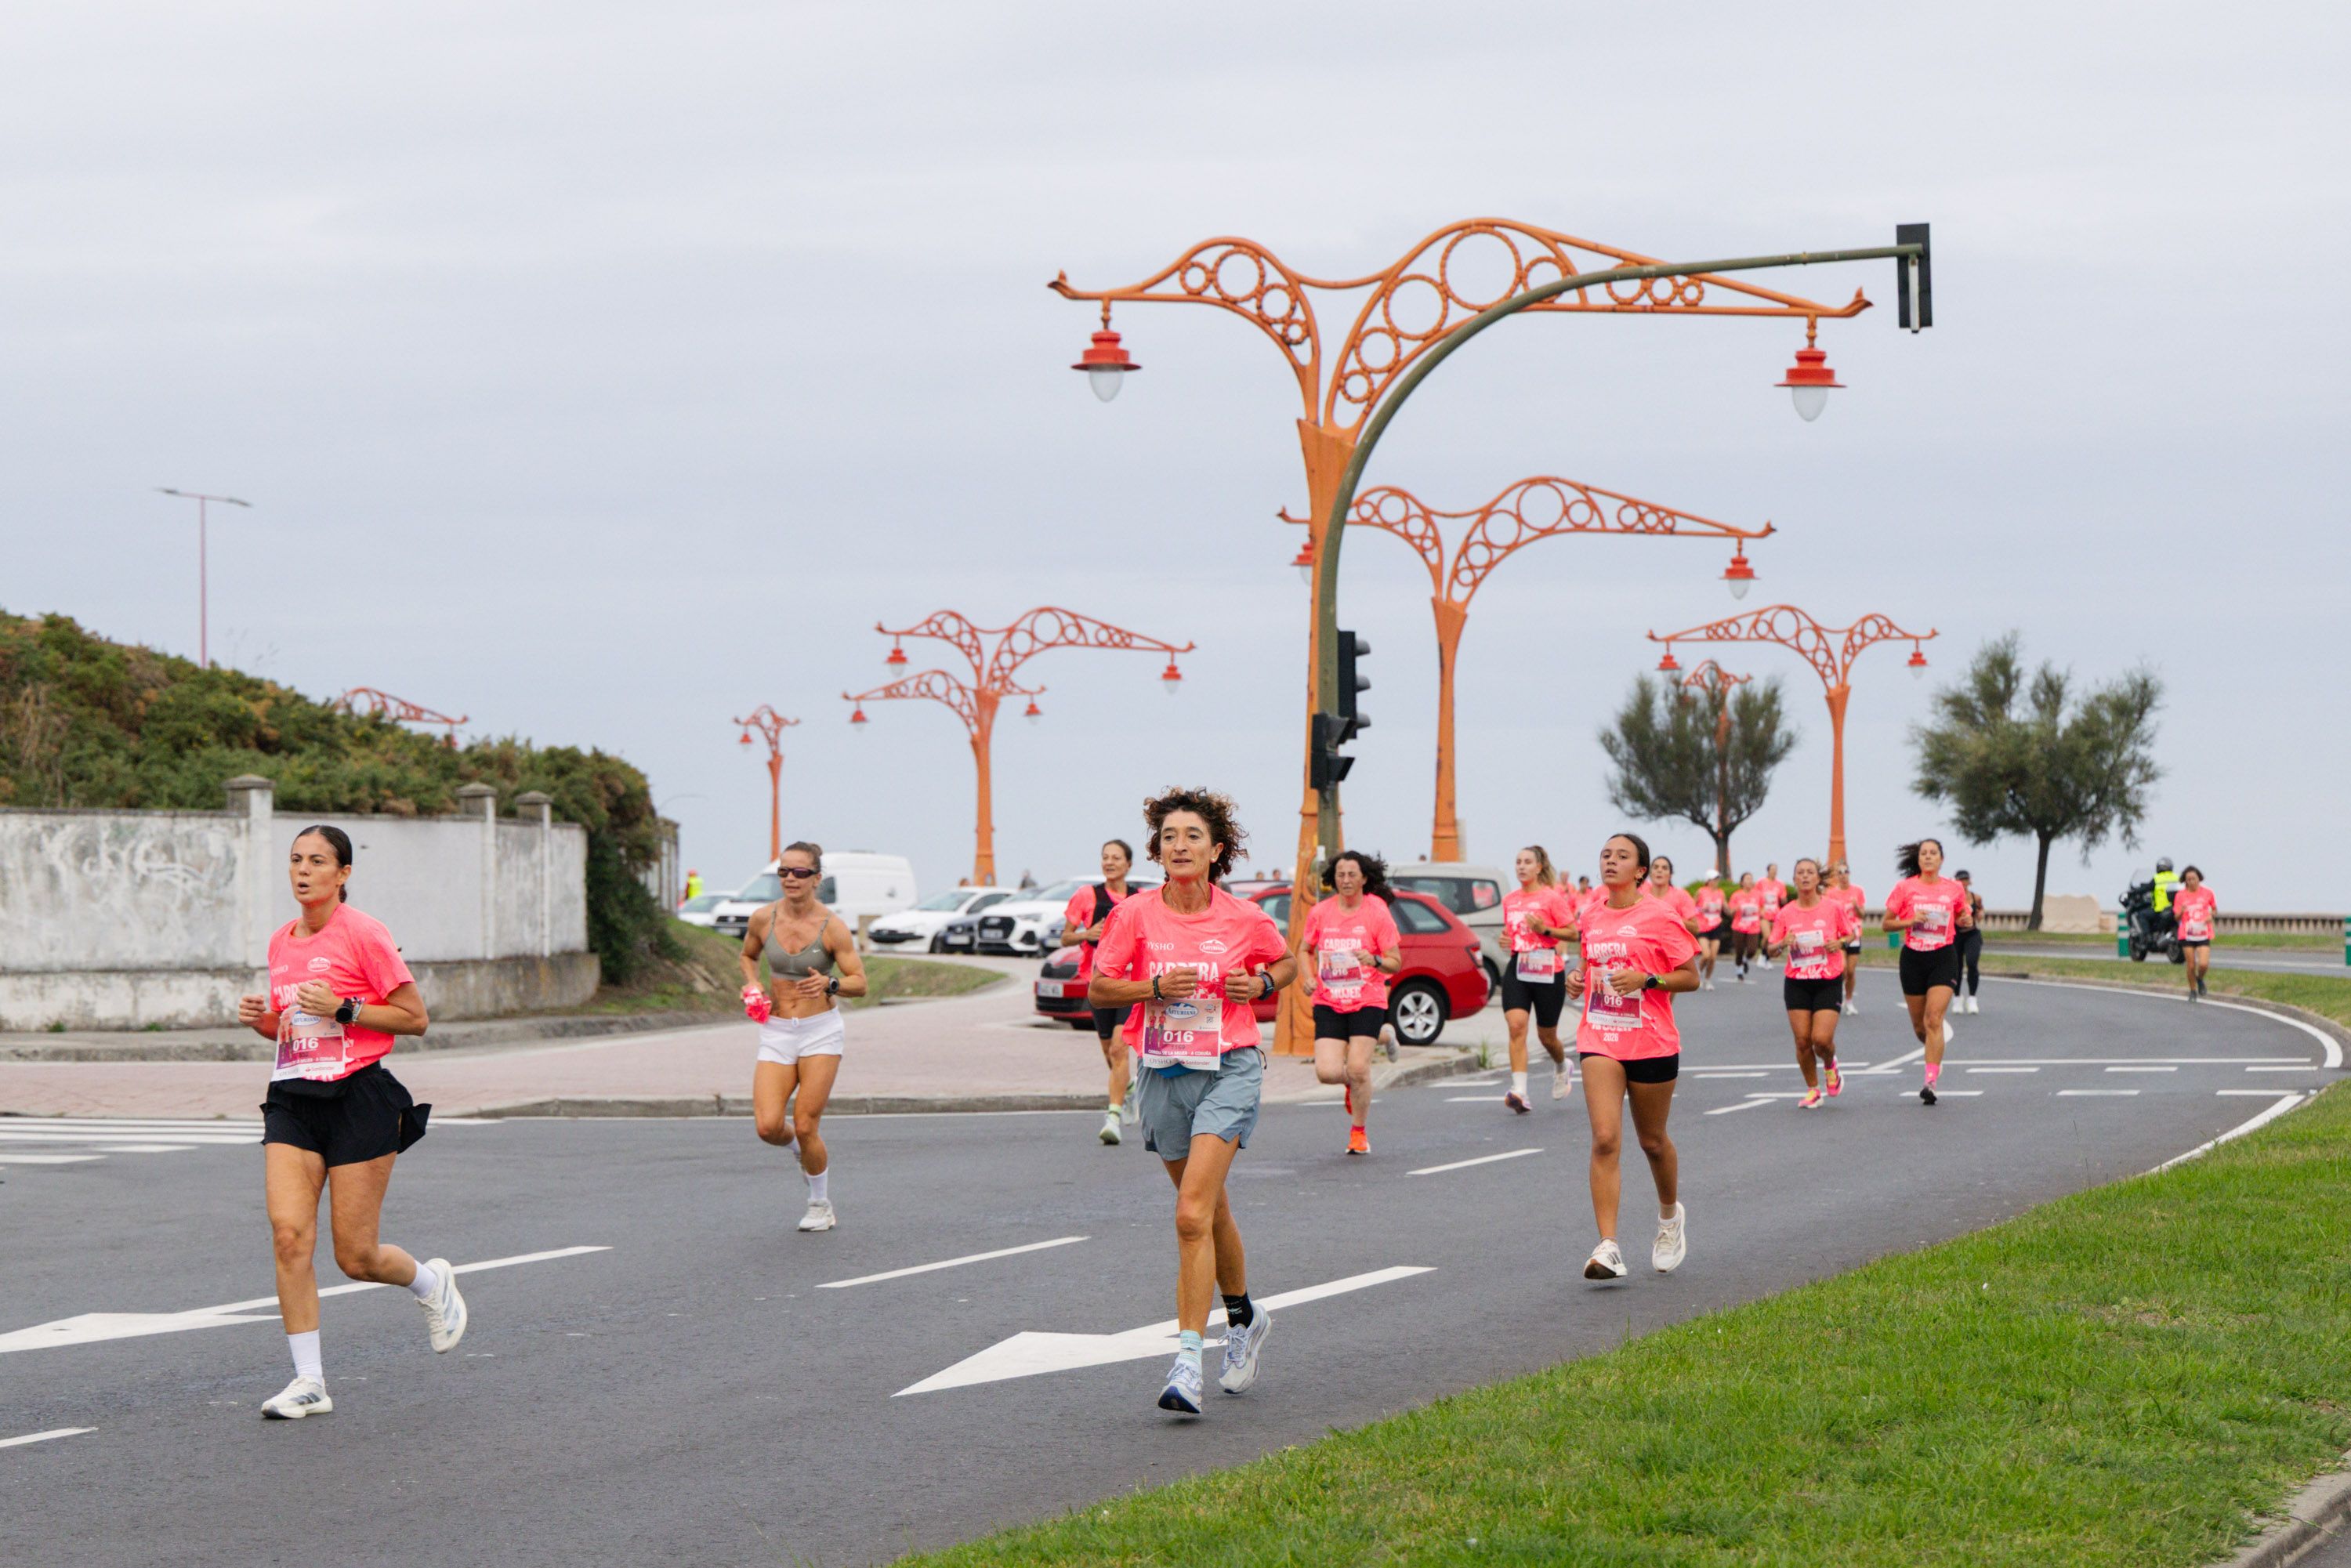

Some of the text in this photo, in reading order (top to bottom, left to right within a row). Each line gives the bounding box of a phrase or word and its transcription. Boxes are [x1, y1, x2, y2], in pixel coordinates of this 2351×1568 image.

[1324, 938, 1362, 950] CARRERA
[1586, 942, 1627, 959] ARRERA
[1604, 995, 1622, 1006] 016
[1163, 1030, 1194, 1043] 016
[292, 1037, 319, 1052] 016
